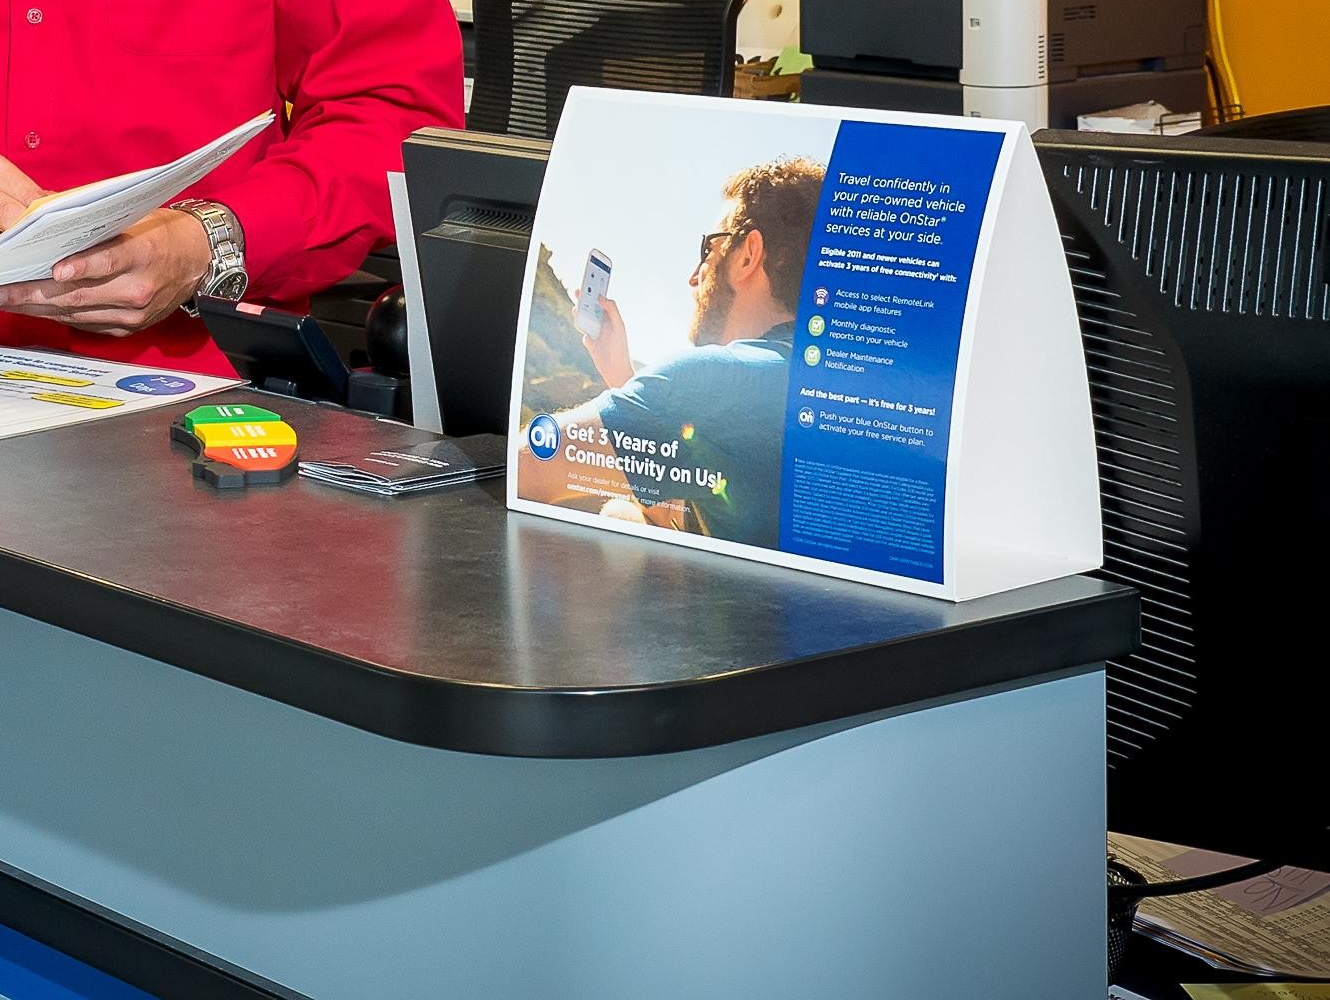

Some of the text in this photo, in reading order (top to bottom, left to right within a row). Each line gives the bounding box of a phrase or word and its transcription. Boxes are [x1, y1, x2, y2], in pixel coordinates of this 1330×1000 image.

[838, 172, 950, 194] Travel confidently in
[833, 190, 966, 213] your pre-owned vehicle
[830, 206, 853, 218] with
[855, 209, 897, 223] reliable
[825, 222, 943, 245] services at your side.
[818, 259, 845, 269] activate
[846, 262, 852, 270] 3
[852, 264, 870, 272] years
[871, 265, 880, 273] of
[880, 266, 893, 275] free
[820, 246, 940, 268] Eligible 2011 and newer vehicles can
[833, 300, 902, 317] mobile app features
[835, 288, 935, 309] Access to select RemoteLink
[830, 318, 896, 335] Monthly diagnostic
[829, 331, 908, 349] reports on your vehicle
[825, 360, 865, 373] Notification
[826, 348, 894, 365] Dealer Maintenance
[799, 387, 815, 398] And
[815, 390, 828, 399] the
[828, 391, 844, 402] best
[844, 395, 860, 404] part
[880, 399, 895, 410] free
[895, 402, 907, 412] for
[907, 404, 913, 412] 3
[913, 406, 936, 416] years!
[819, 410, 934, 437] Push your blue OnStar button to
[565, 422, 679, 459] Get 3 Years of
[818, 423, 926, 447] activate your free service plan.
[565, 444, 666, 482] Connectivity
[670, 466, 691, 484] on
[567, 471, 578, 479] Ask
[592, 476, 610, 485] dealer
[611, 480, 620, 488] for
[620, 481, 640, 492] details
[640, 498, 657, 507] more
